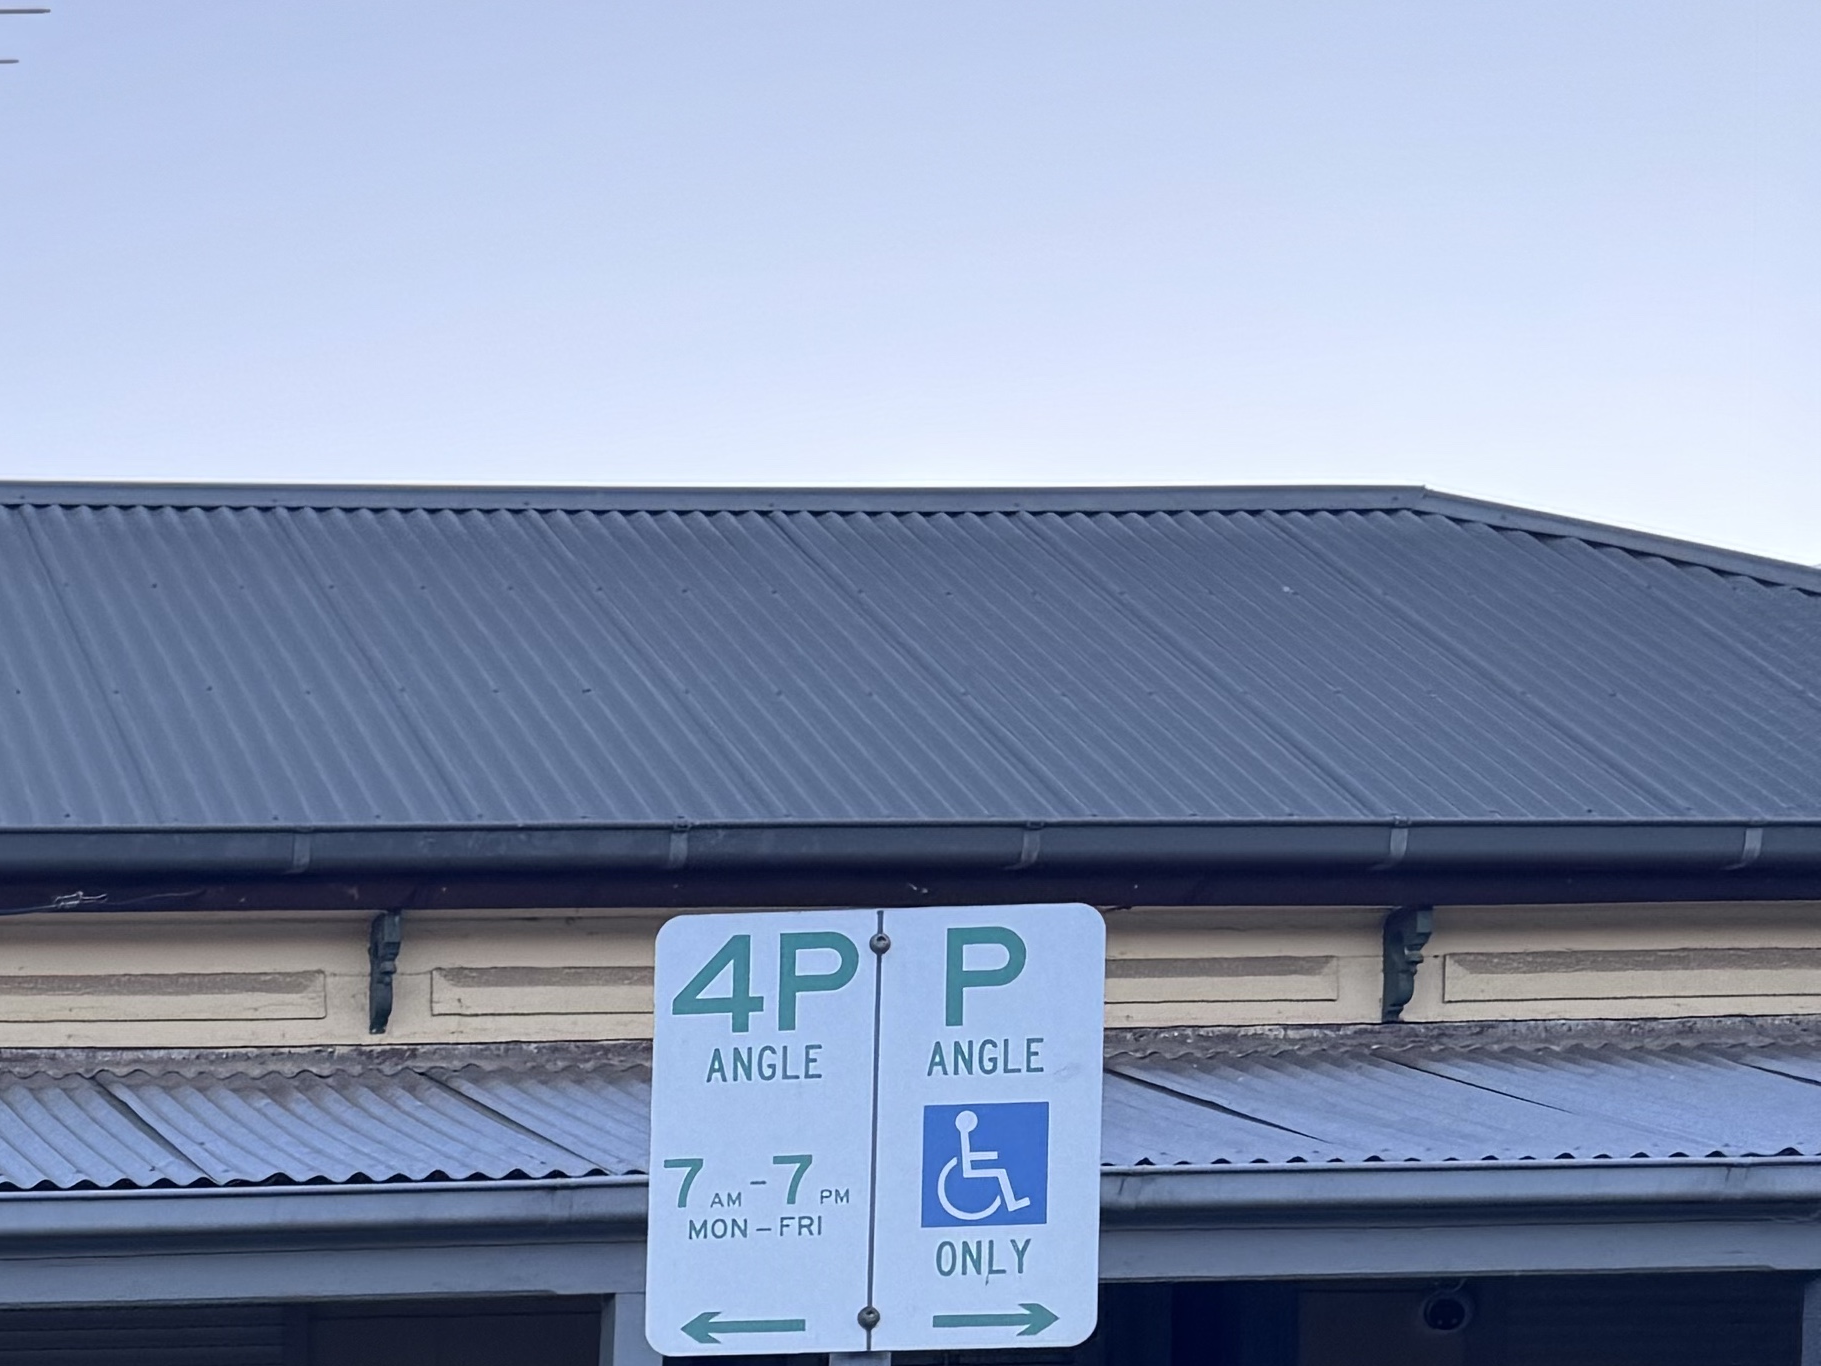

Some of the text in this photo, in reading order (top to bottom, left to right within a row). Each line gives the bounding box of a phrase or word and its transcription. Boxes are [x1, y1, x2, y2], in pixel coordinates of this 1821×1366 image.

[672, 931, 860, 1034] 4P
[945, 926, 1028, 1027] P
[705, 1043, 823, 1083] ANGLE
[926, 1037, 1045, 1077] ANGLE
[935, 1238, 1032, 1277] ONLY
